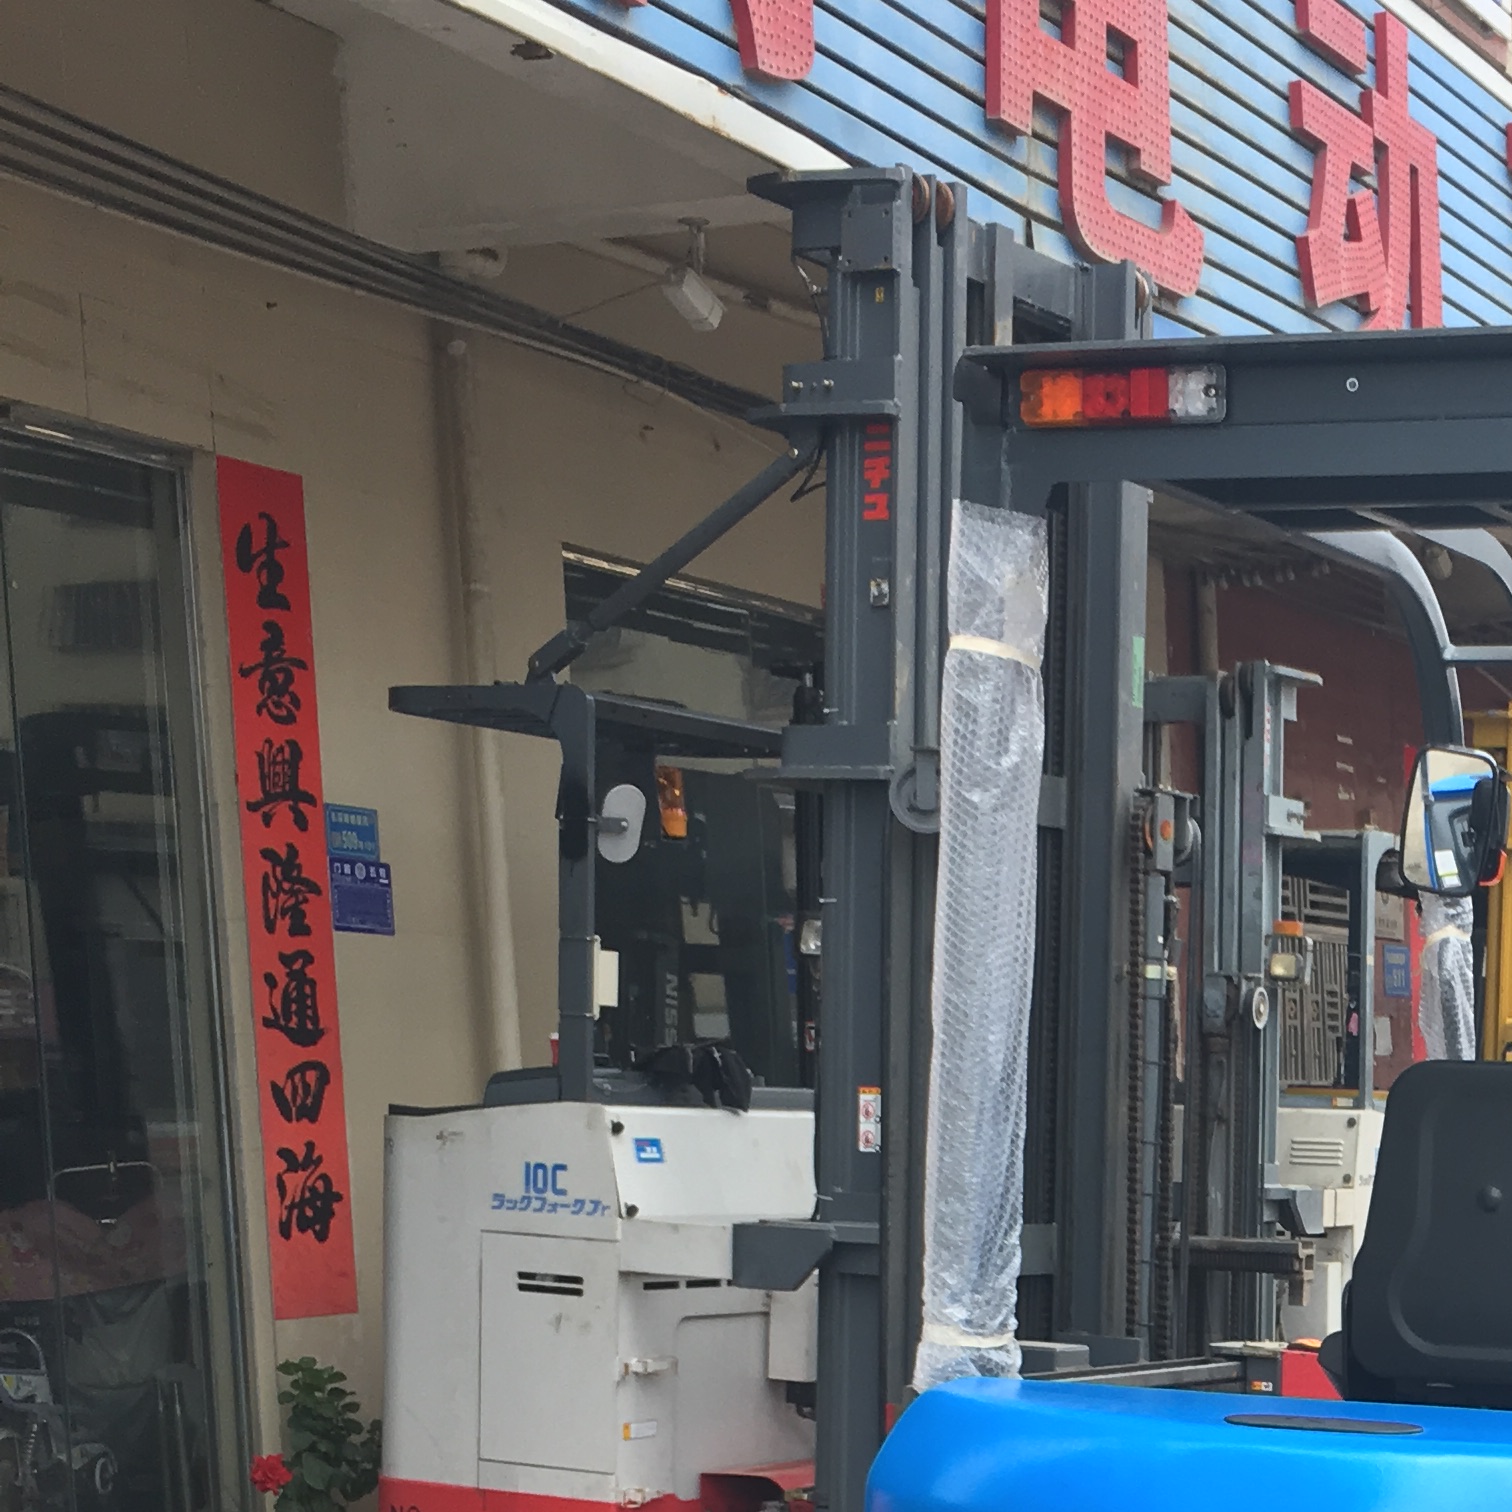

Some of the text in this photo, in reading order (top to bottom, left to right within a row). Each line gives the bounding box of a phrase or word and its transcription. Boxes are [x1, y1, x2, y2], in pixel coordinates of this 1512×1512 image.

[235, 511, 344, 1243] 生意興隆通四海
[665, 972, 678, 1047] NISS
